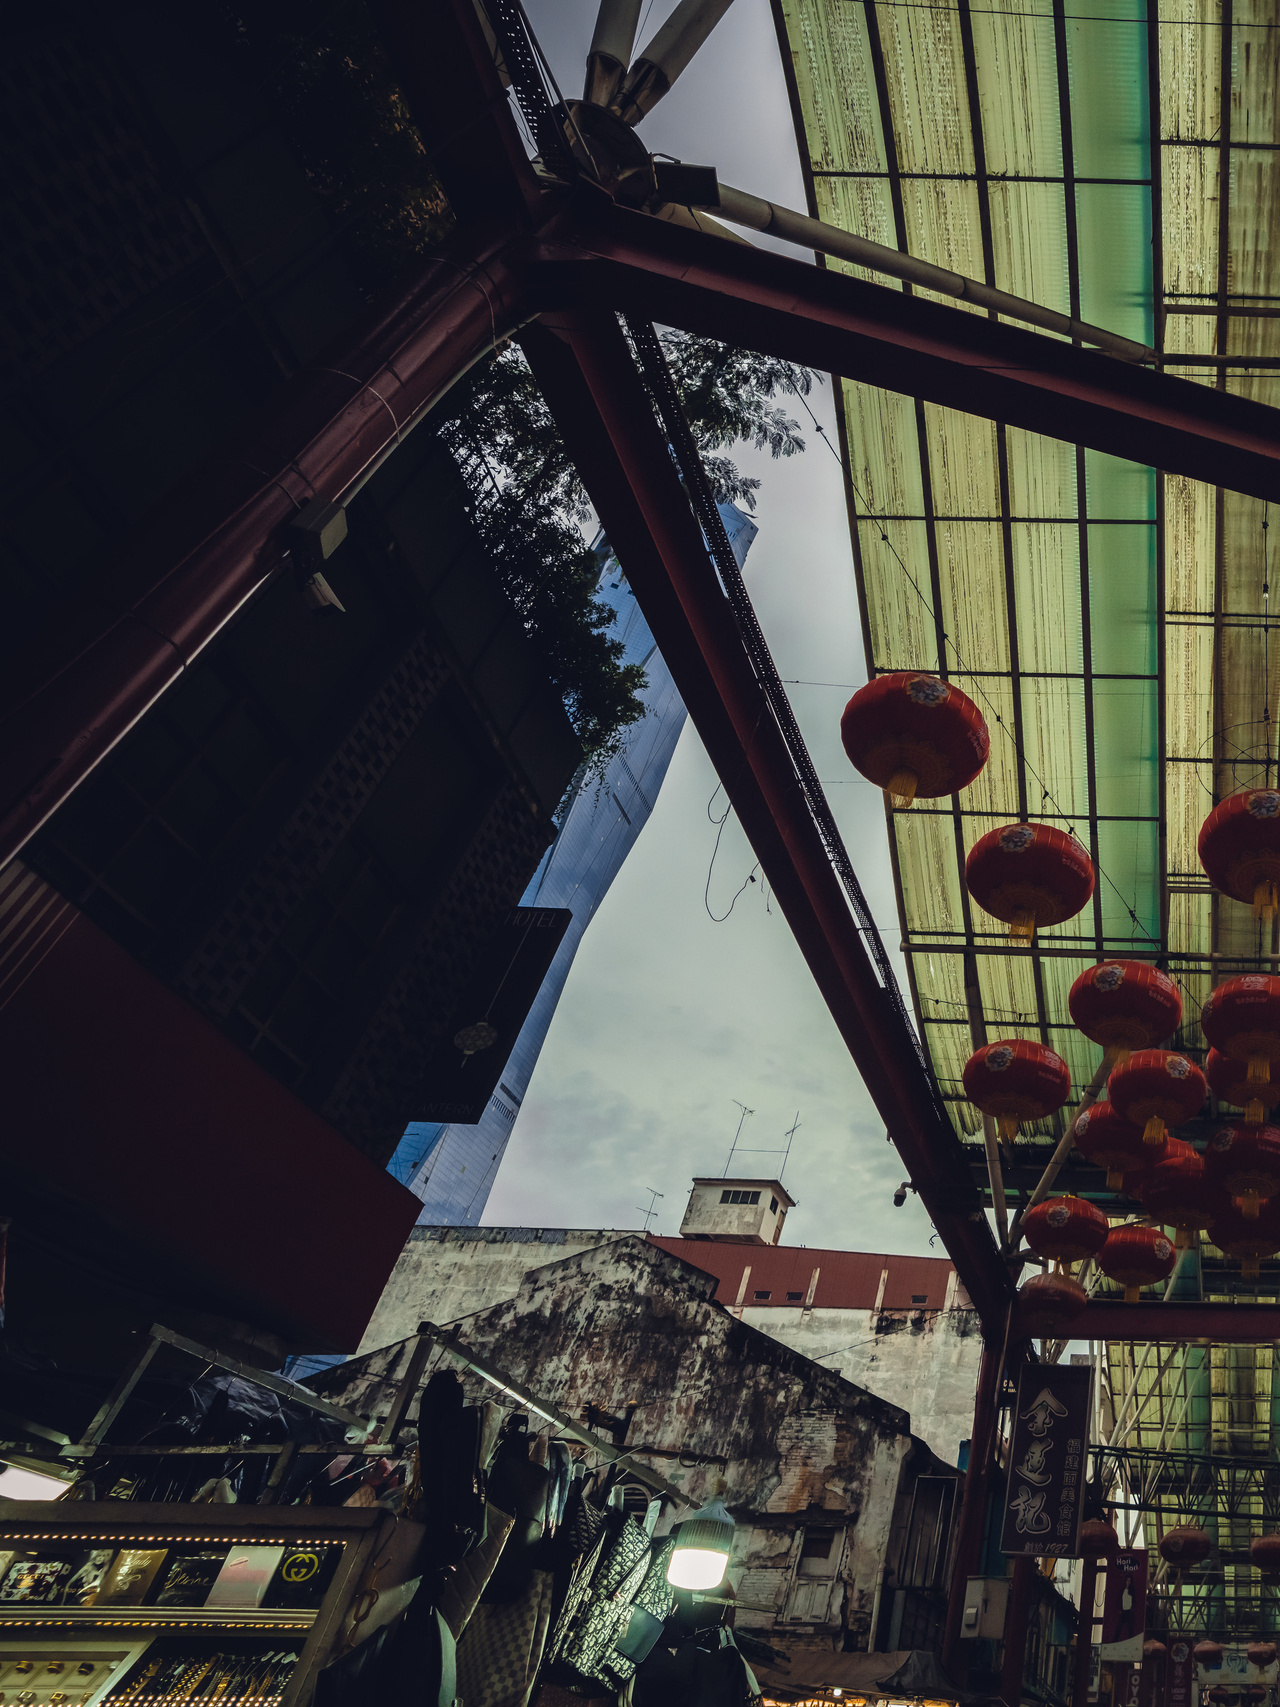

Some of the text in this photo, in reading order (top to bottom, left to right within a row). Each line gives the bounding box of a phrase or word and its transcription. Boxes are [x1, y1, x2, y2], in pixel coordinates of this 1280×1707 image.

[504, 910, 558, 928] HOTEL
[409, 1102, 475, 1116] LANTERN
[1045, 1542, 1069, 1554] 1927
[1116, 1557, 1131, 1566] Hari
[1124, 1564, 1138, 1572] Hari
